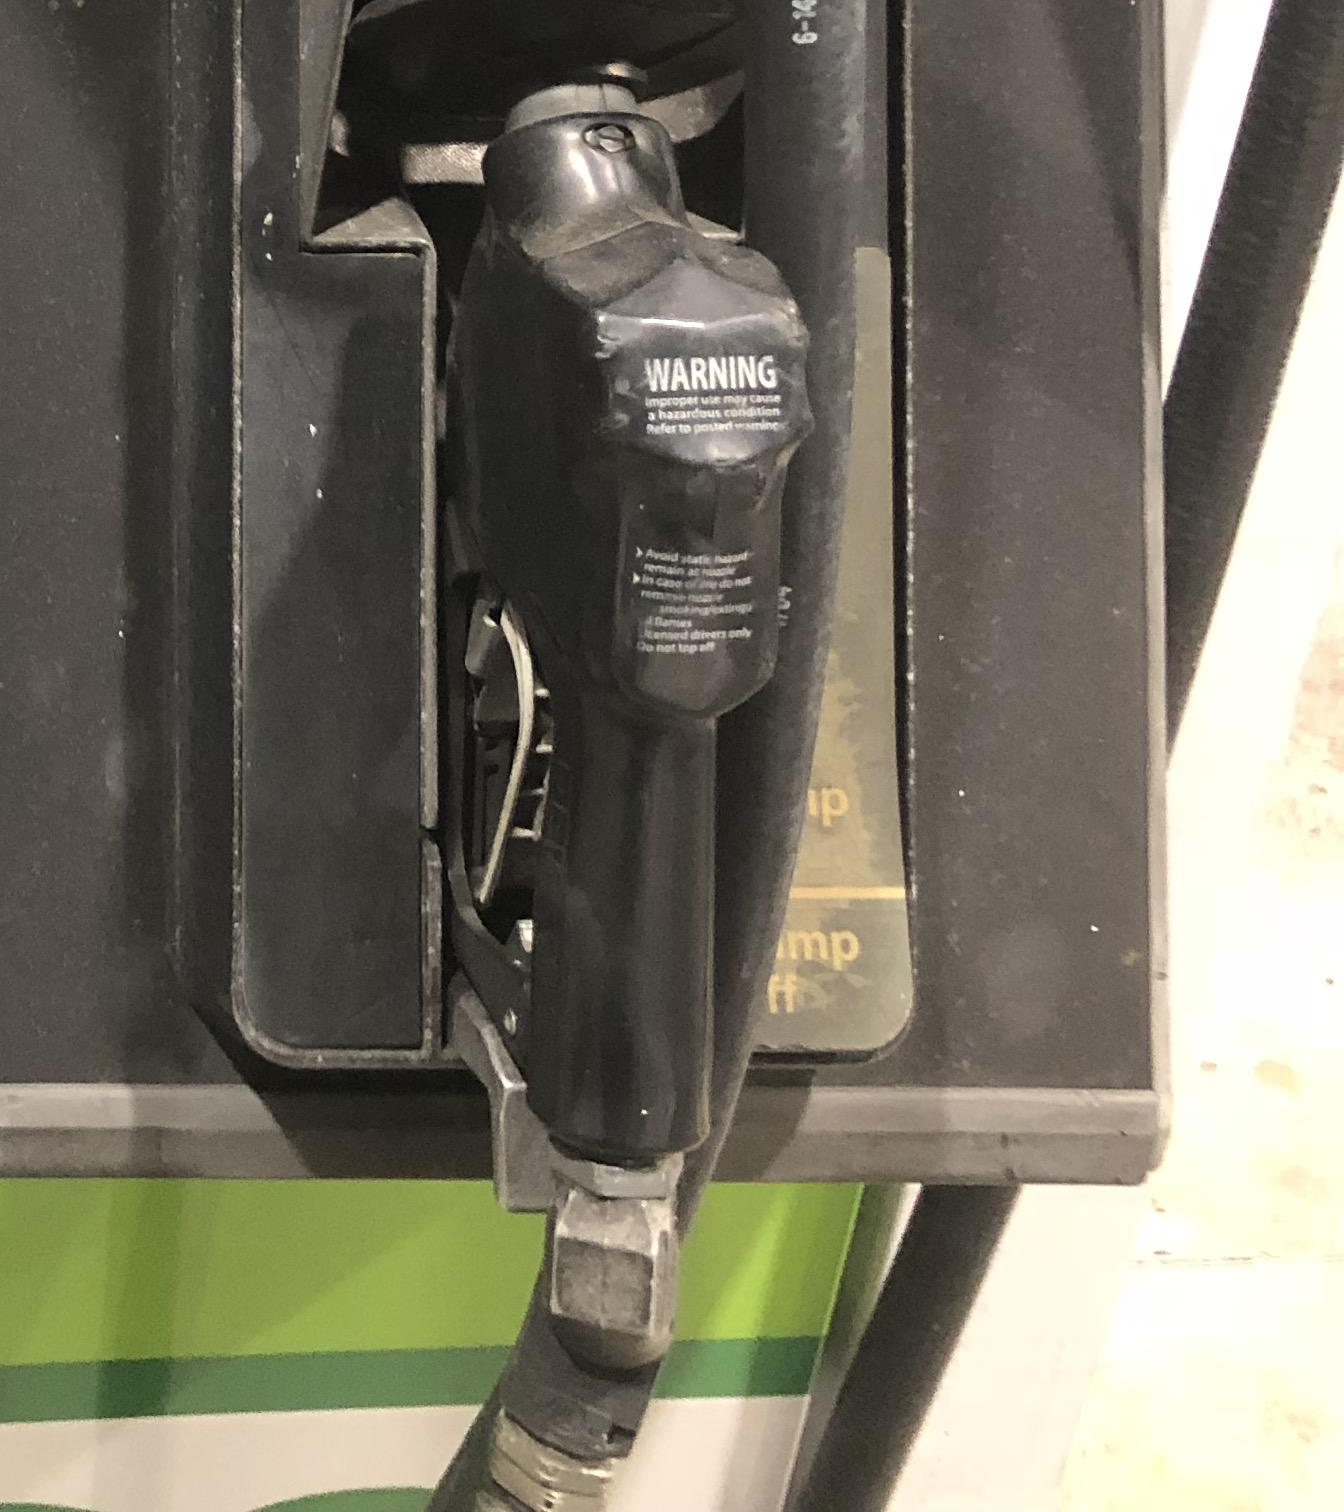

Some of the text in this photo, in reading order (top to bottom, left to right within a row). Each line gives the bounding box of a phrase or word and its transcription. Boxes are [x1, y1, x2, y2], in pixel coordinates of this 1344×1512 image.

[644, 355, 778, 392] WARNING
[645, 394, 781, 408] Improper use may cause
[647, 406, 780, 421] a hazardous condition
[646, 421, 733, 435] Refer to posted
[645, 548, 679, 563] Avoid
